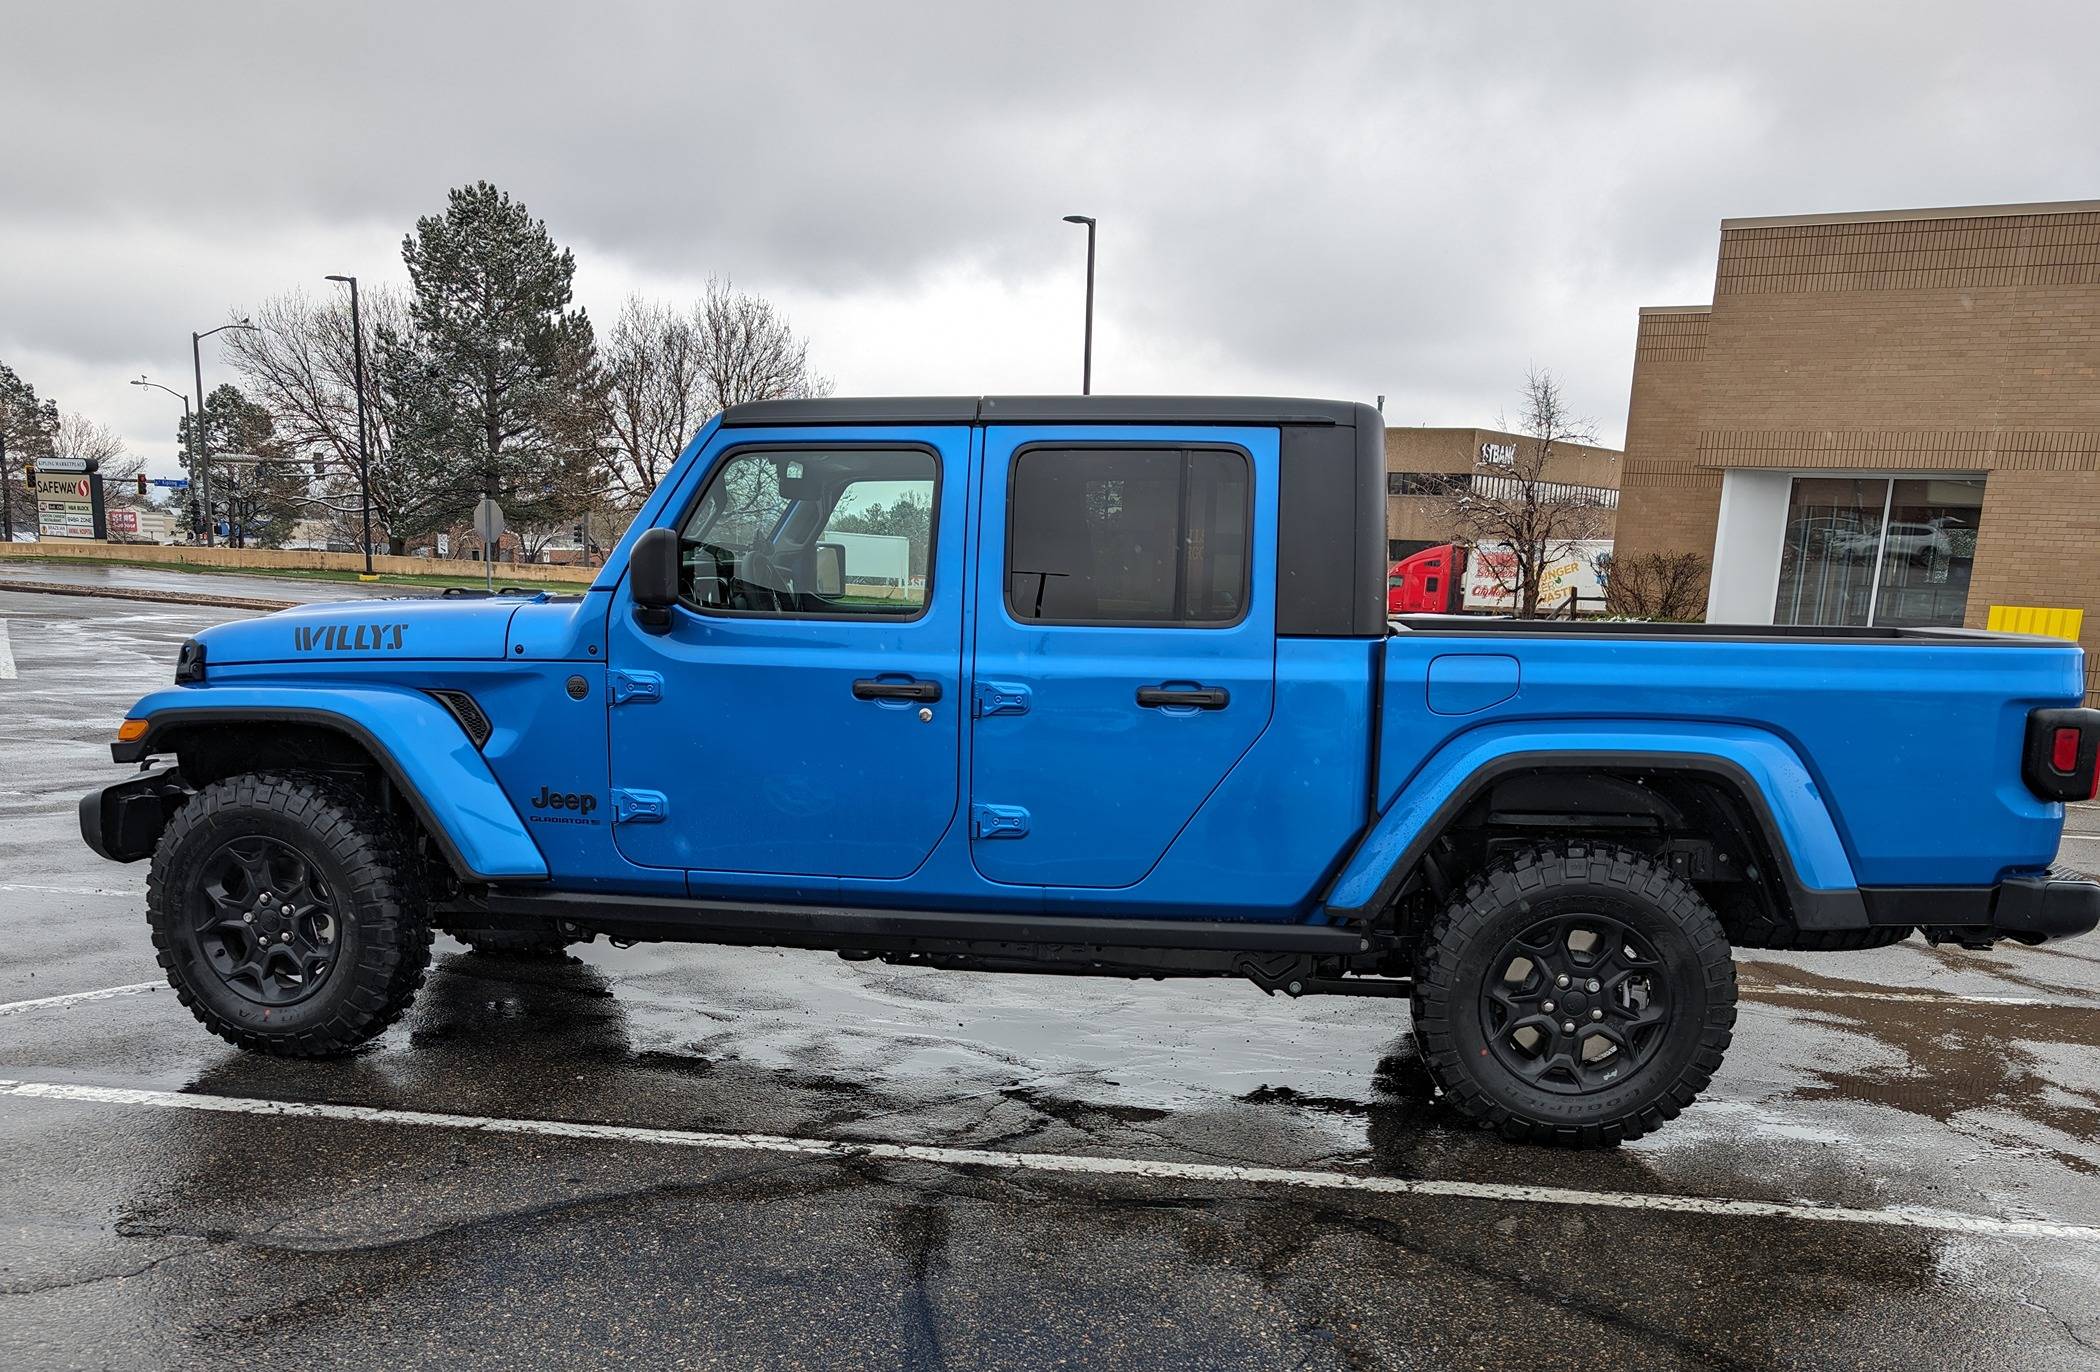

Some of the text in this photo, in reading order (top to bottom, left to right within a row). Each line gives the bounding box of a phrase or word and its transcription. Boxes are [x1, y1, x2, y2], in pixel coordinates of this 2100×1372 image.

[37, 480, 77, 494] SAFEWAY
[1536, 562, 1580, 582] UNGER
[1541, 577, 1563, 592] ERO
[294, 623, 409, 651] WILLYS
[531, 785, 597, 815] Jeep
[529, 815, 590, 825] GLADIATOR
